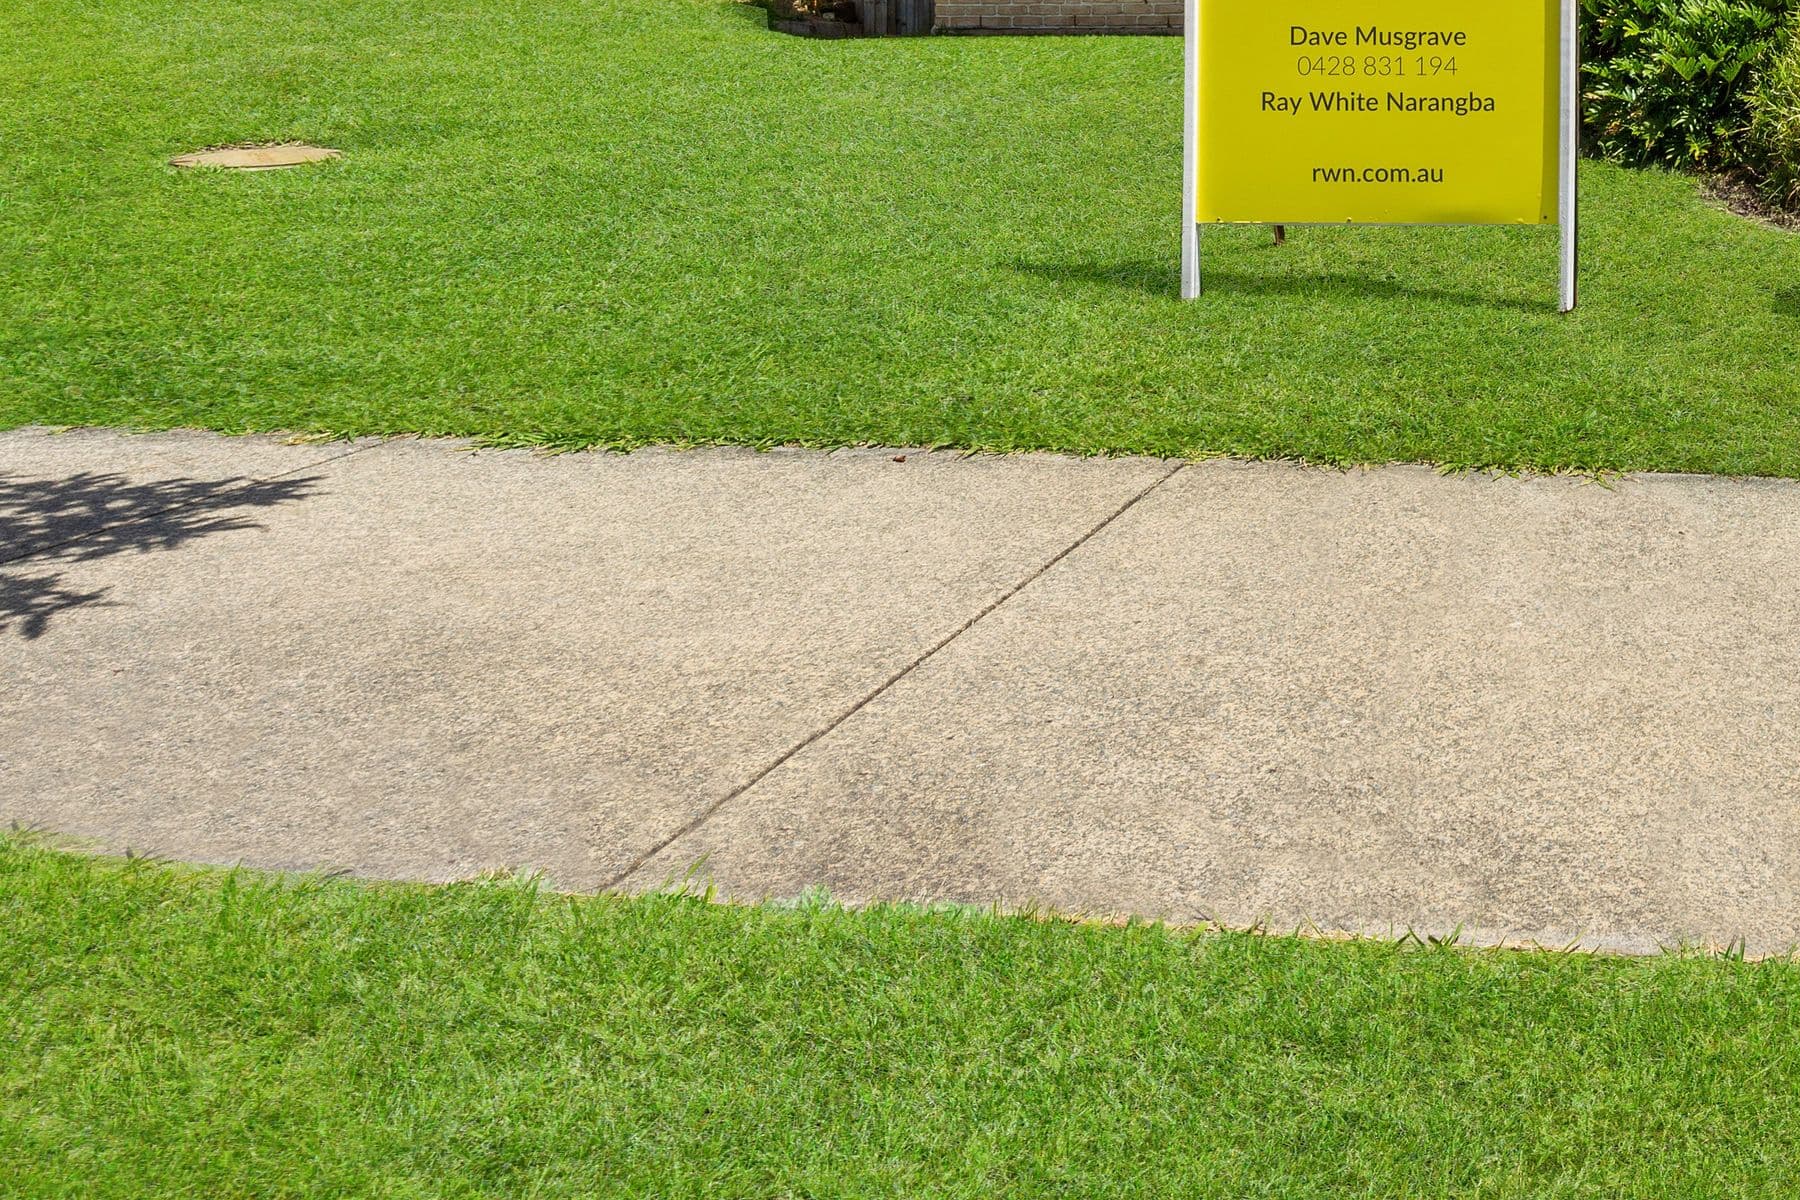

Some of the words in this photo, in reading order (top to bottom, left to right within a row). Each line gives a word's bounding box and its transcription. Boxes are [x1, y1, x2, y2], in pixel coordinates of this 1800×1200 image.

[1290, 26, 1348, 46] Dave
[1355, 26, 1467, 50] Musgrave
[1297, 55, 1356, 76] 0428
[1363, 55, 1406, 76] 831
[1415, 55, 1458, 76] 194
[1261, 91, 1303, 115] Ray
[1309, 91, 1379, 112] White
[1387, 91, 1495, 116] Narangba
[1311, 166, 1443, 183] rwn.com.au
